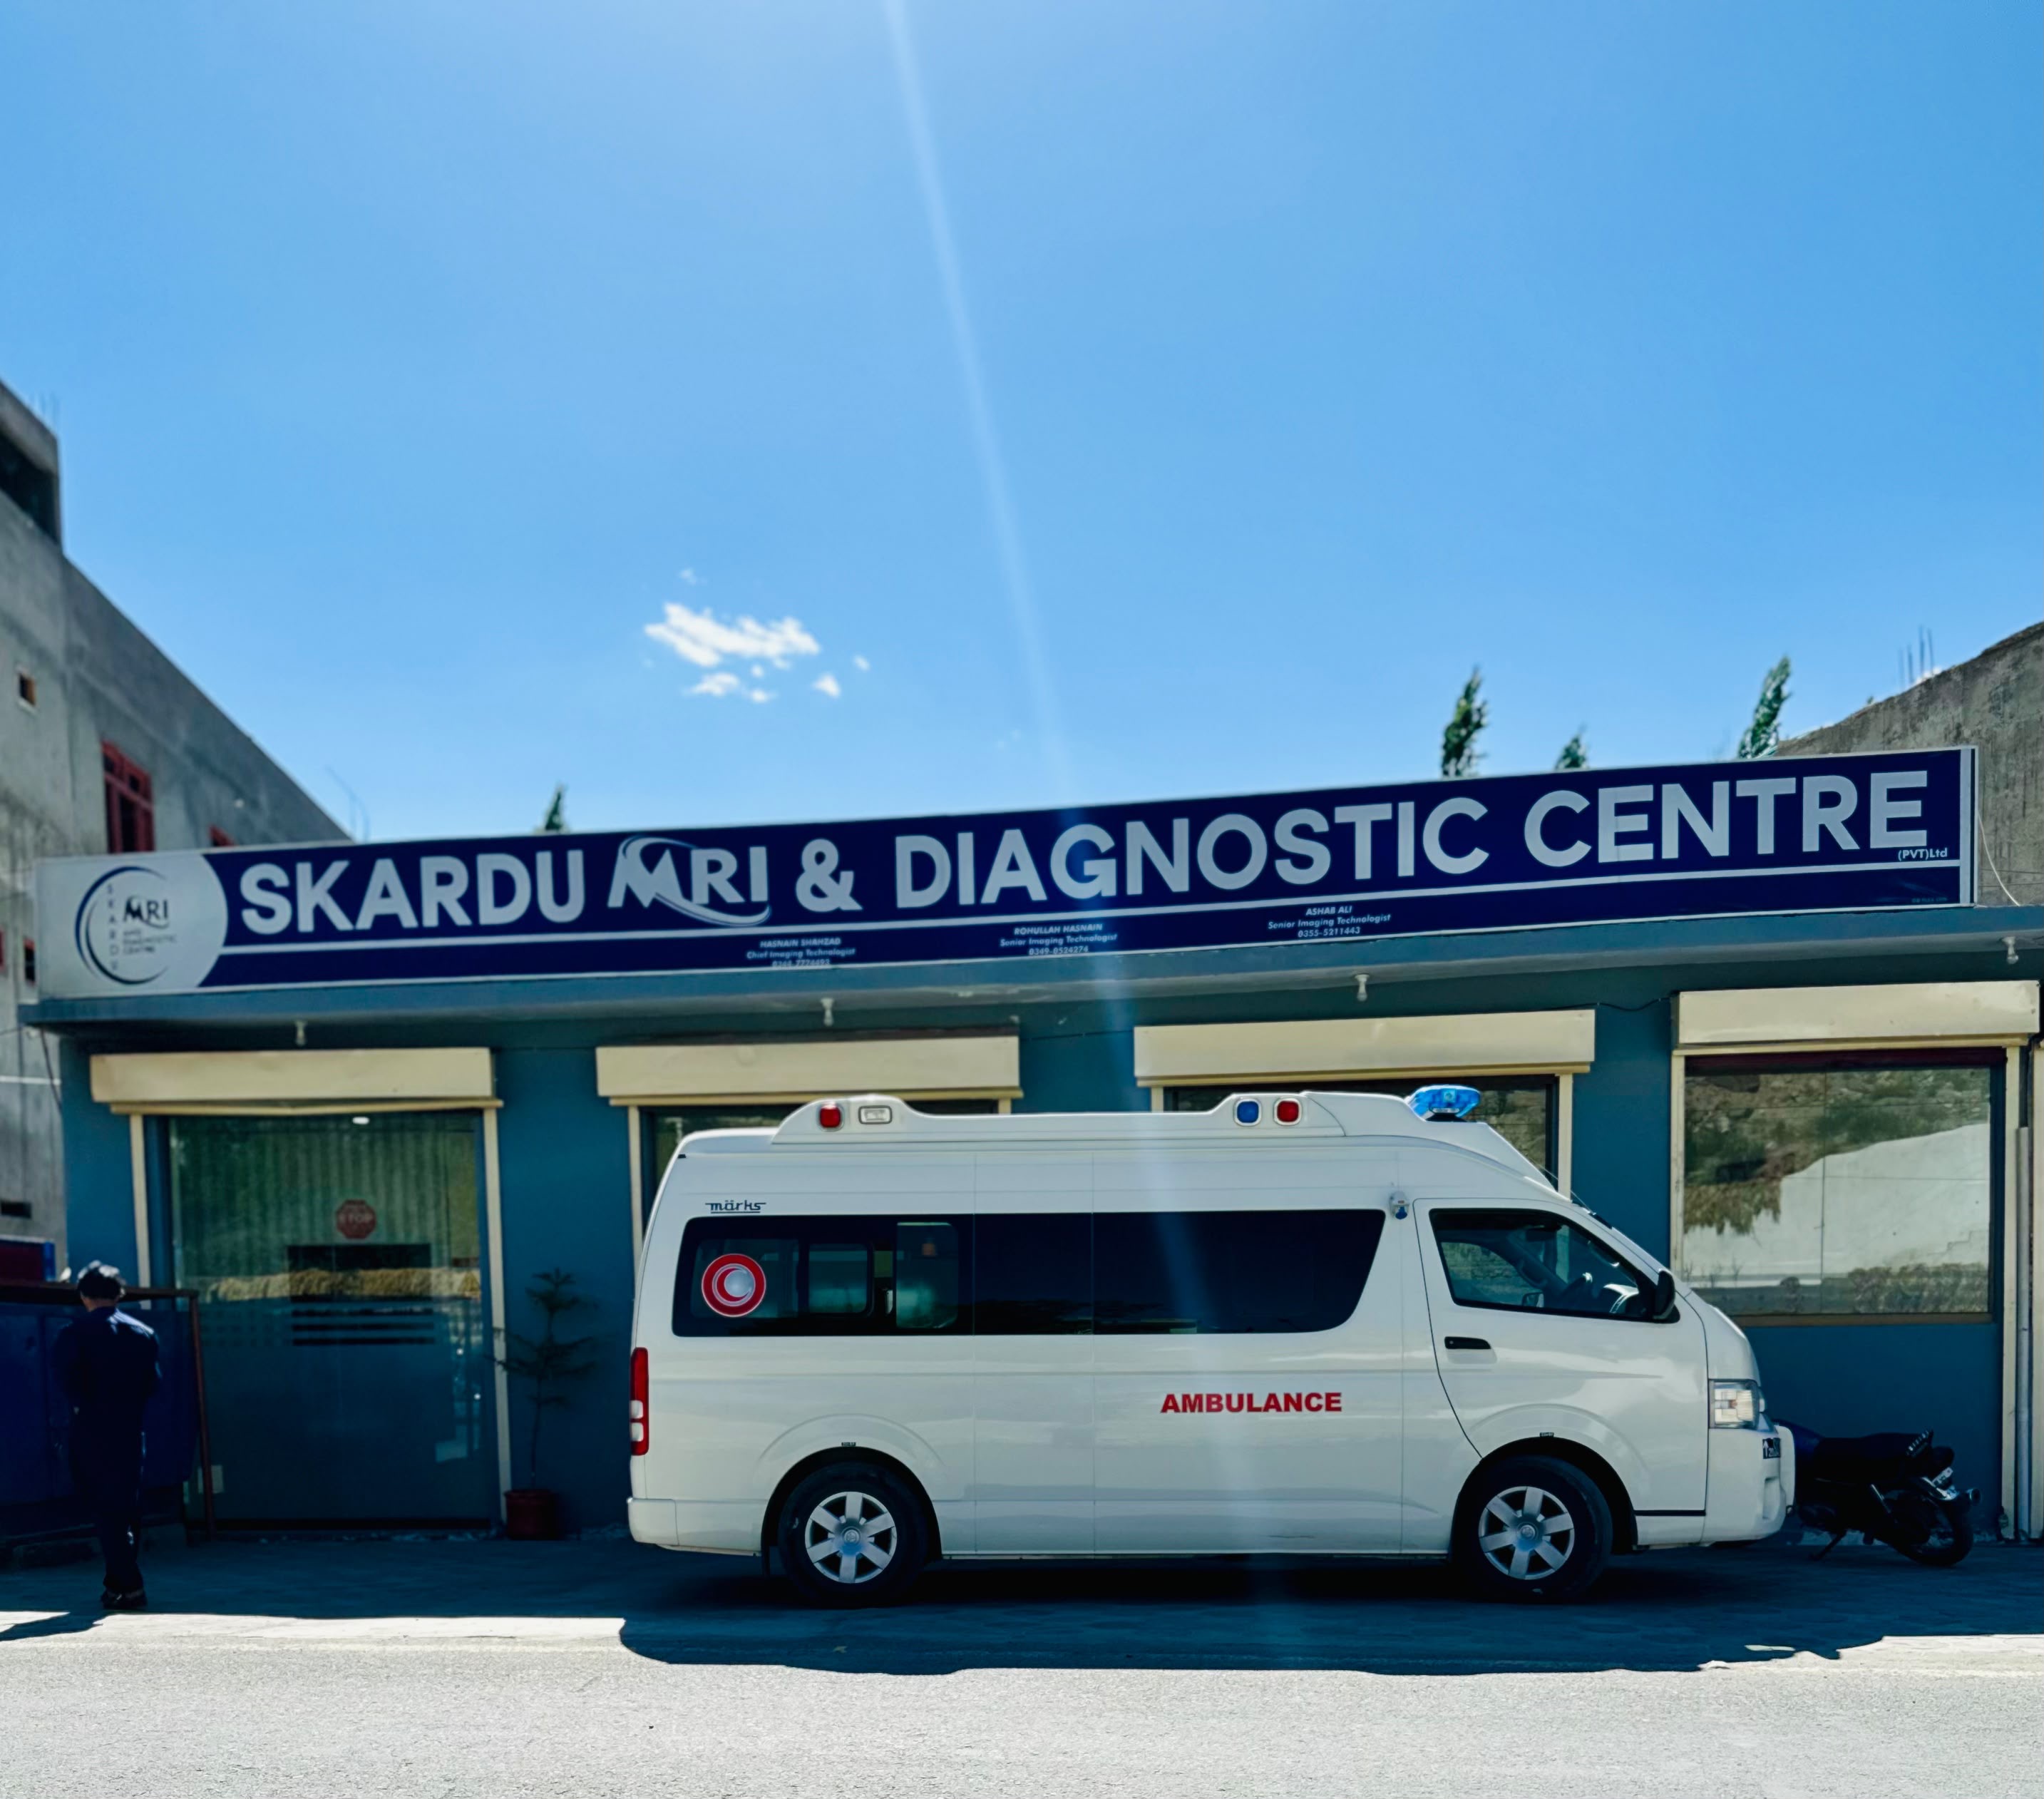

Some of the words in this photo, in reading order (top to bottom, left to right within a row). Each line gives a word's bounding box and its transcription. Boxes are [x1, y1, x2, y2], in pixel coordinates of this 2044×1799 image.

[240, 849, 585, 936] SKARDU
[607, 837, 771, 926] MRI
[796, 838, 862, 912] &
[895, 797, 1489, 909] DIAGNOSTIC
[1524, 770, 1928, 867] CENTRE
[1897, 847, 1948, 861] (PVT)Ltd
[123, 896, 170, 929] MRI
[1305, 906, 1335, 916] ASHAB
[1268, 921, 1295, 929] Senior
[1298, 918, 1335, 928] Imaging
[1337, 913, 1391, 925] Technologist
[1014, 926, 1061, 936] ROHULLAH
[1063, 923, 1104, 933] HASNAIN
[1298, 926, 1361, 938] 0355-5211443
[760, 939, 798, 948] HASNAIN
[801, 937, 841, 946] SHAHZAD
[1000, 938, 1026, 947] Senior
[1029, 937, 1064, 946] Imaging
[1066, 933, 1118, 943] Technologist
[746, 950, 769, 959] Chief
[769, 949, 803, 959] Imaging
[806, 948, 856, 957] Technologist
[1161, 1392, 1342, 1414] AMBULANCE
